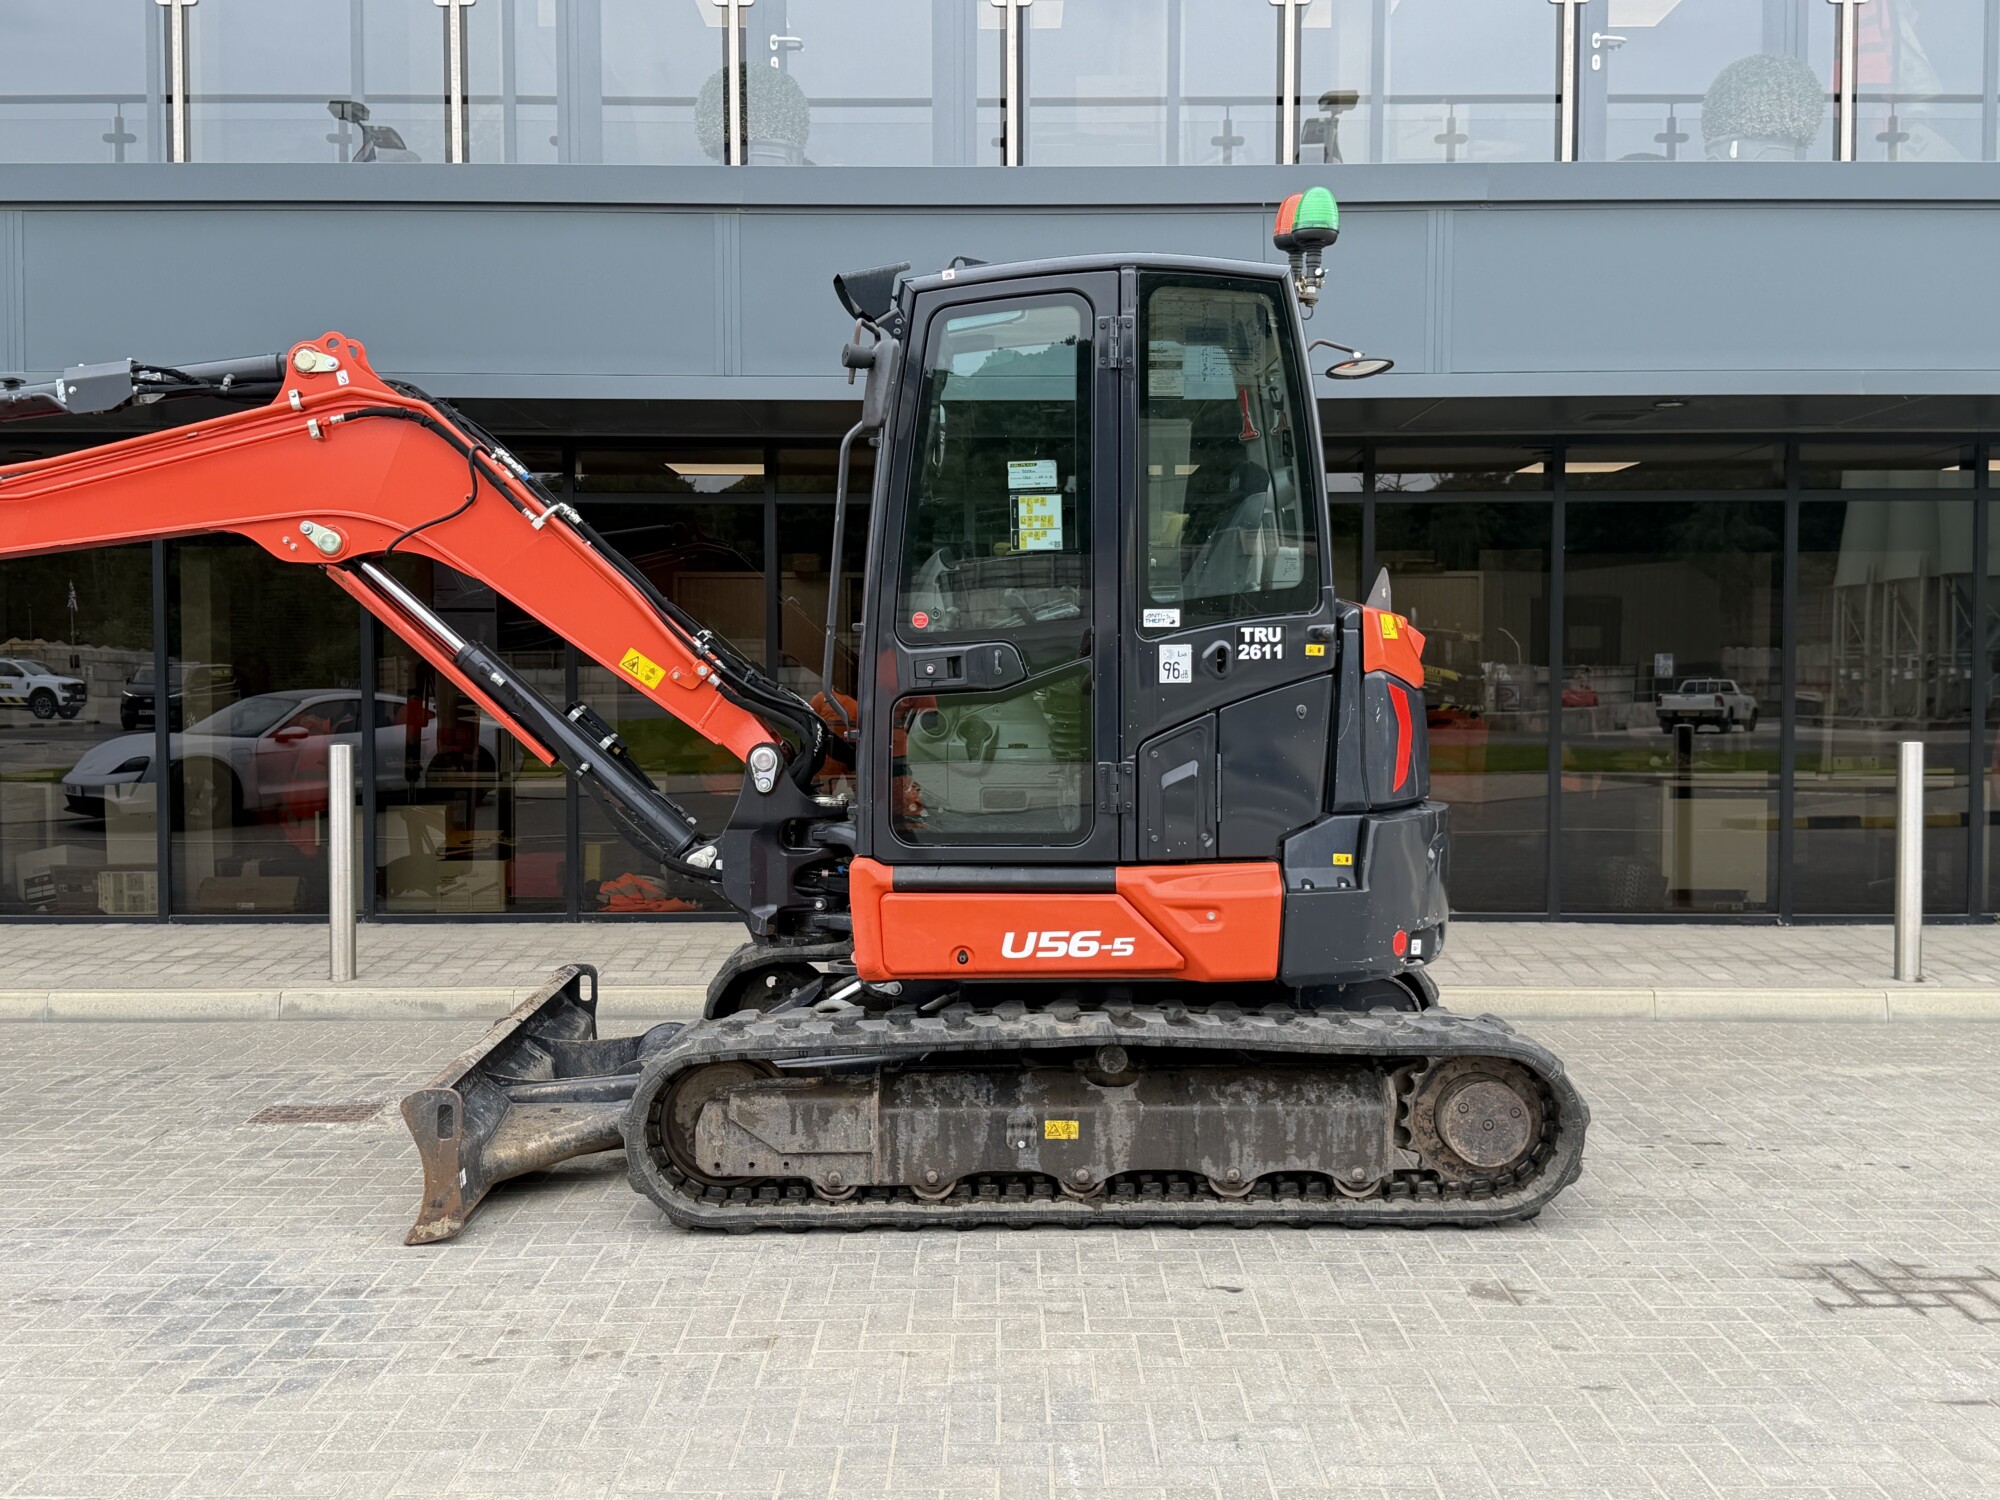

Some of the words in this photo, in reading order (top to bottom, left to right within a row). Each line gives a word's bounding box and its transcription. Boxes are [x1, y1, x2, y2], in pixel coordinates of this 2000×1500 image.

[1240, 627, 1282, 643] TRU
[1238, 644, 1283, 660] 2611
[1163, 661, 1180, 680] 96
[1181, 670, 1188, 679] dB
[1001, 930, 1135, 959] U56-5
